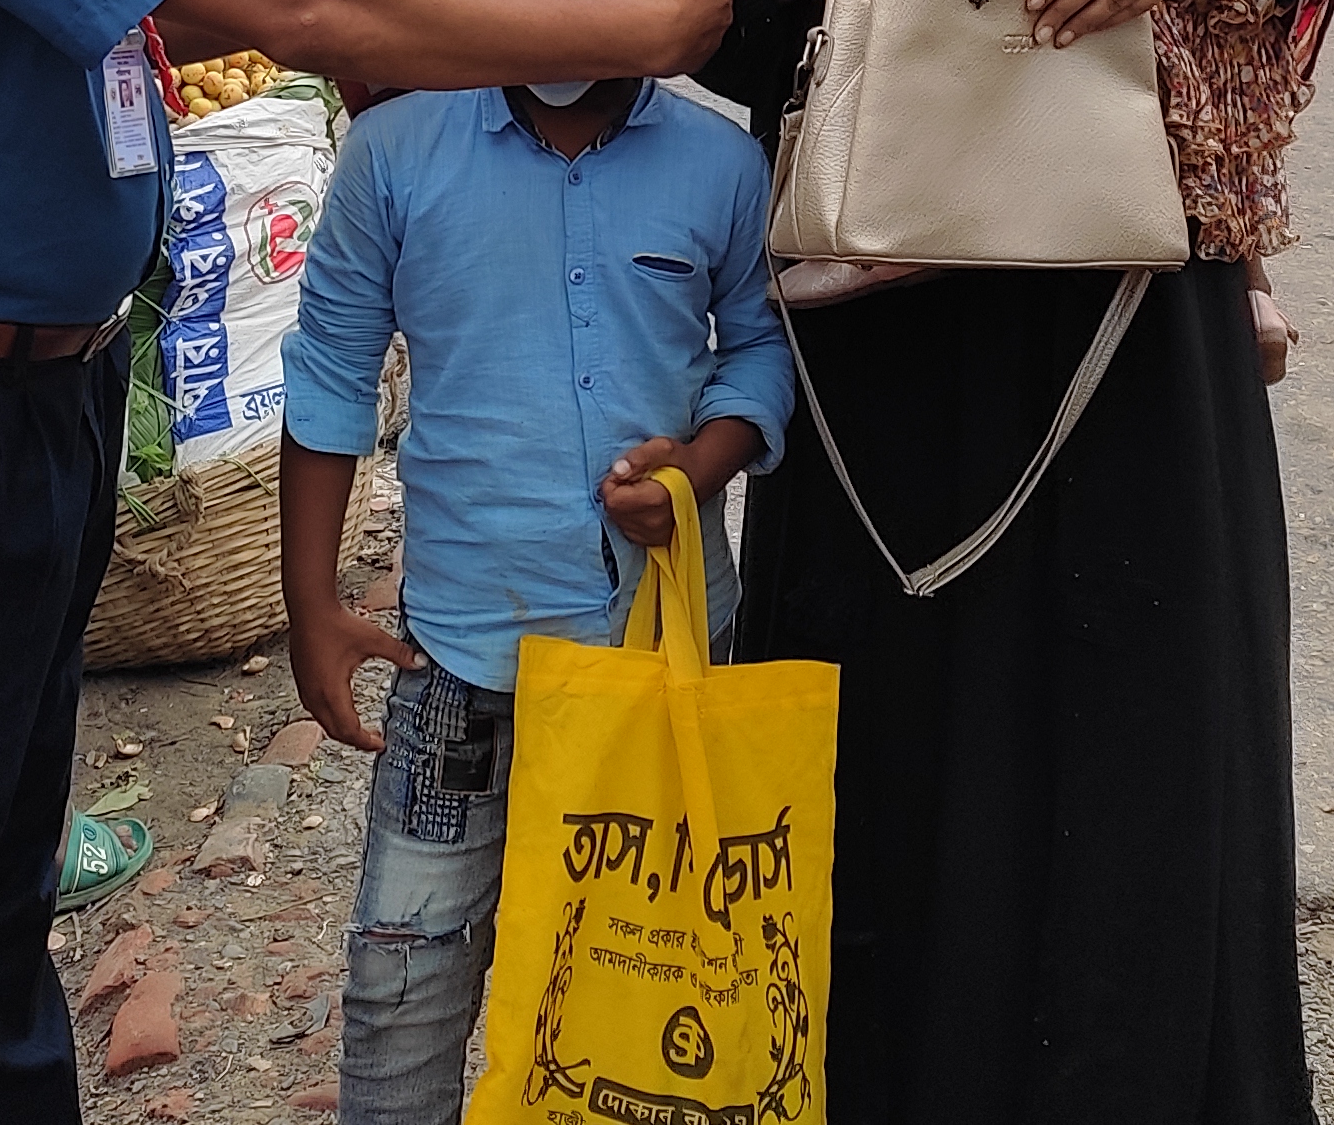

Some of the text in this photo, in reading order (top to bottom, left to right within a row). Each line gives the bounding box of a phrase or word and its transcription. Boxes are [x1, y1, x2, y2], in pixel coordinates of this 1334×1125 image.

[608, 916, 644, 944] সকল
[647, 928, 687, 950] প্রকার
[589, 946, 687, 983] আমদানীকারক
[597, 1089, 676, 1125] দোকান
